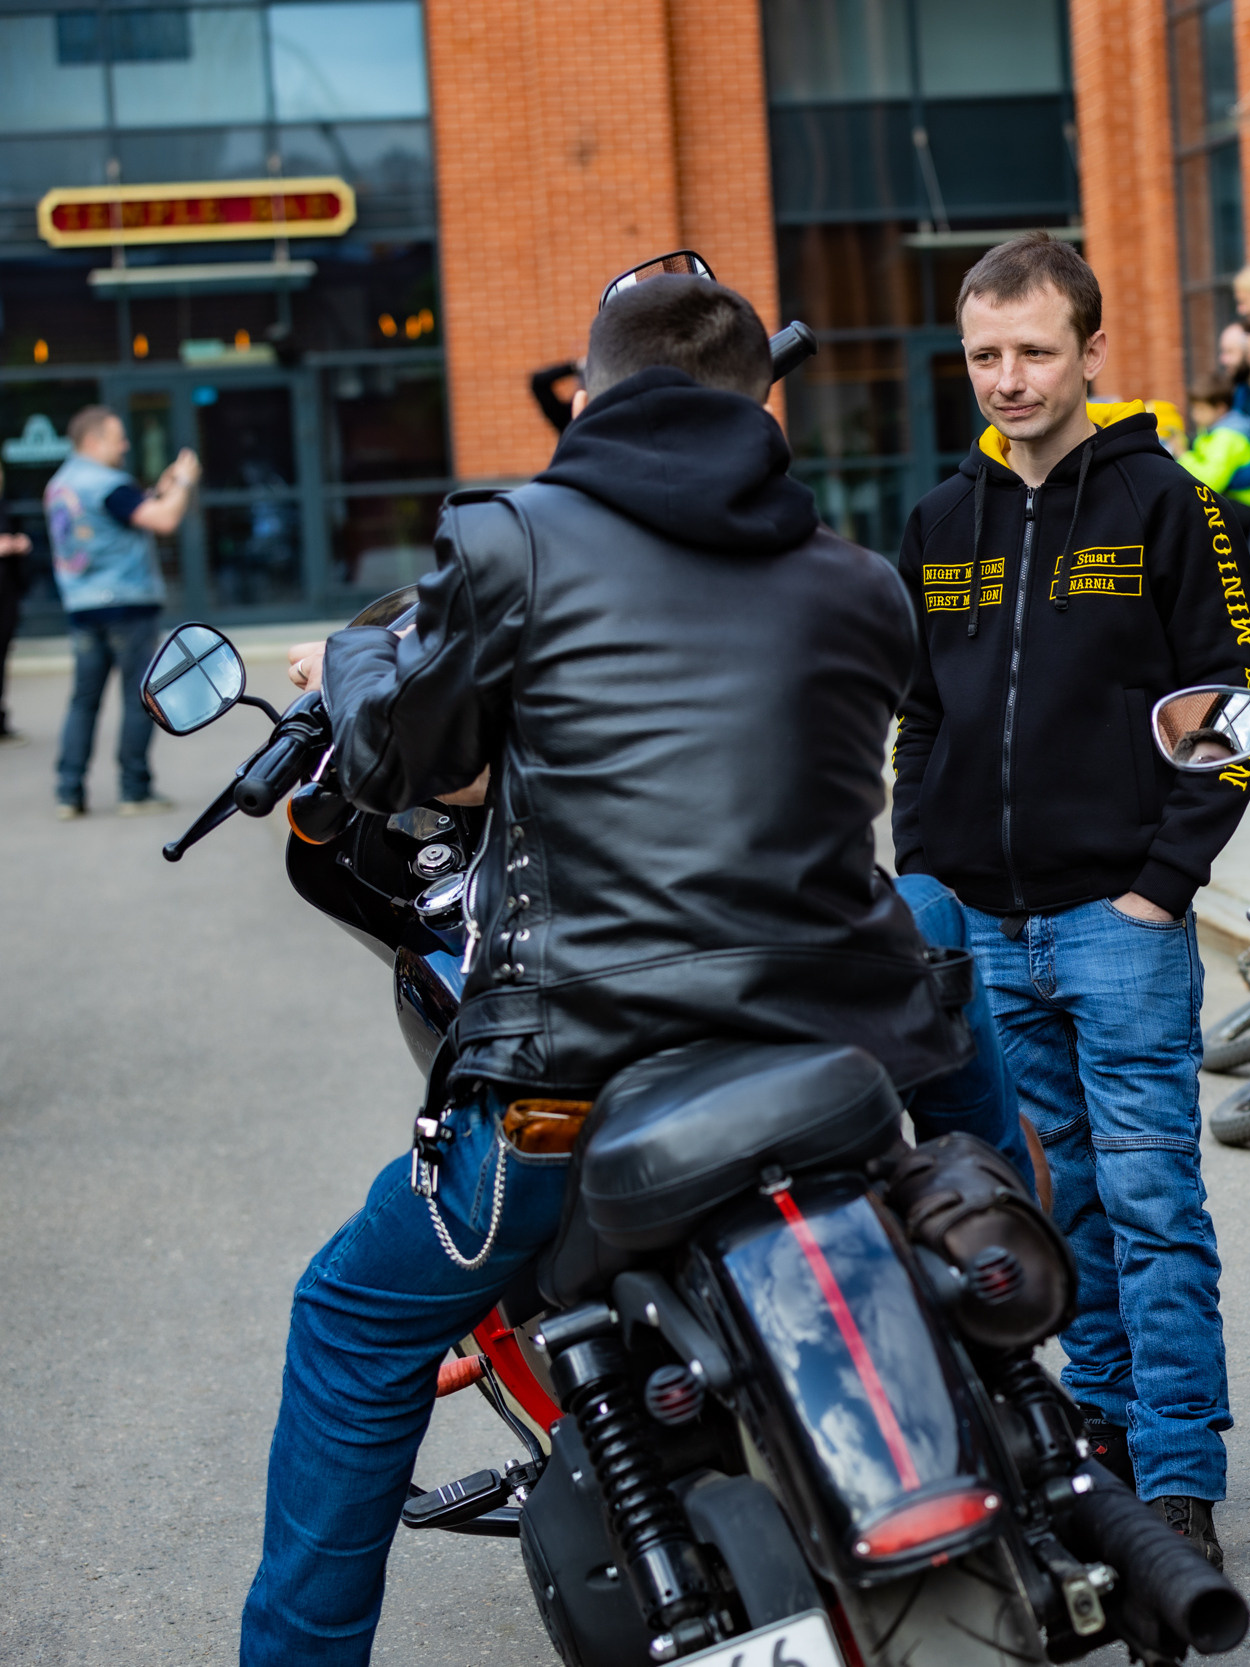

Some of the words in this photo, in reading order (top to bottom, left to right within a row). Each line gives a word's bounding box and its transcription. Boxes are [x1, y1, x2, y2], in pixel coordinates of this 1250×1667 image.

[1077, 551, 1117, 564] Stuart
[925, 568, 961, 580] NIGHT
[965, 562, 1003, 579] MIONS
[1069, 578, 1116, 591] NARNIA
[928, 596, 959, 607] FIRST
